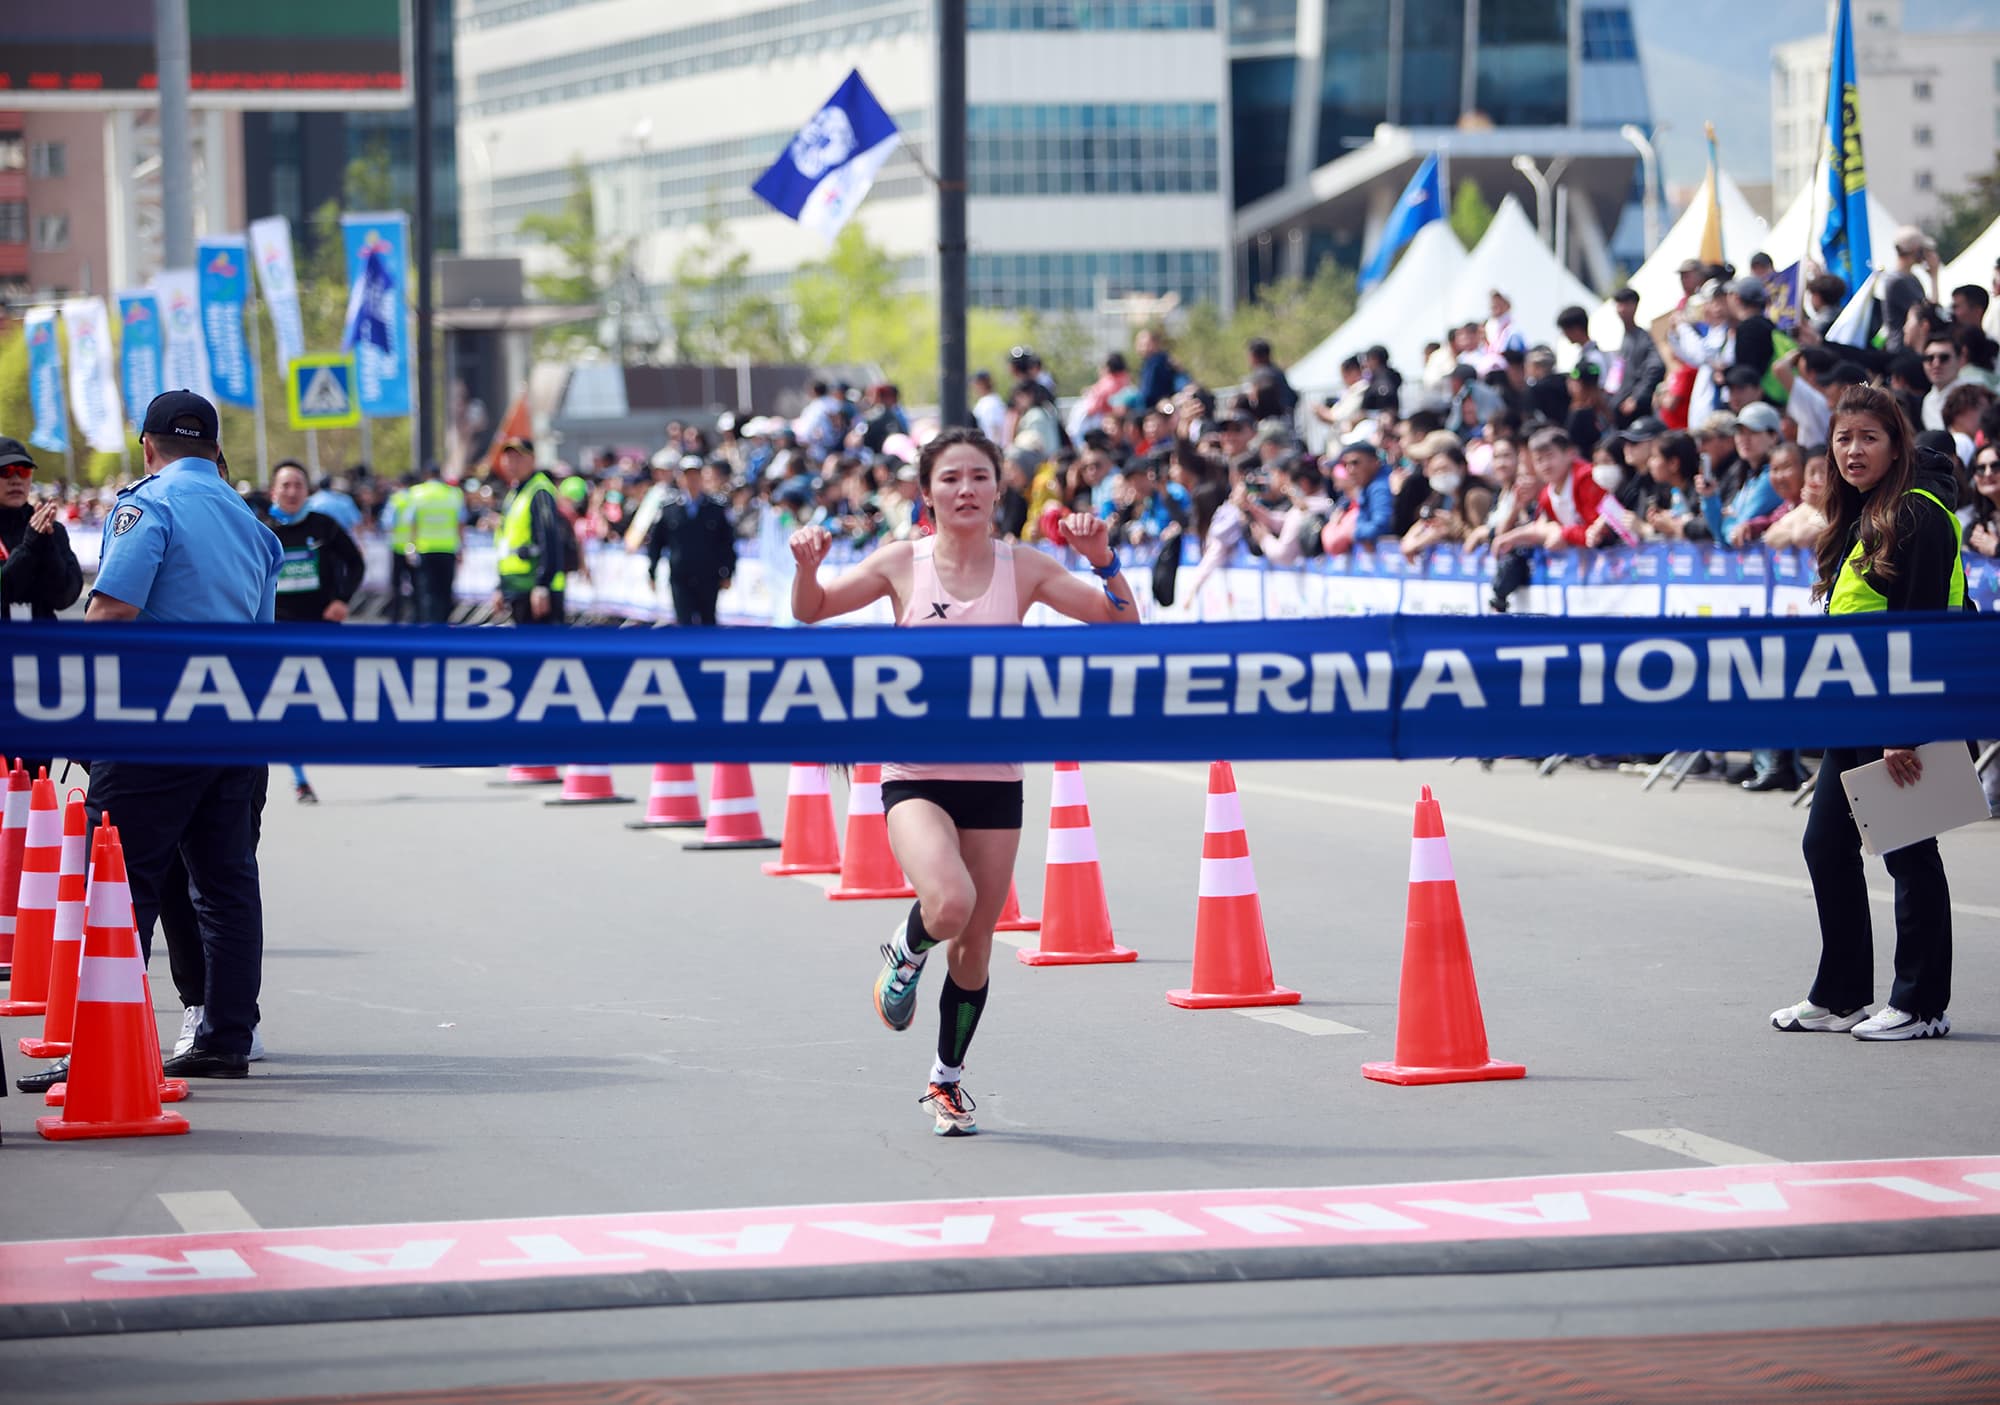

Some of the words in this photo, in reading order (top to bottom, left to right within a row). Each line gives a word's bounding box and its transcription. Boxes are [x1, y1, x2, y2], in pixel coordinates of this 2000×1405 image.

[175, 427, 201, 437] POLICE
[12, 654, 928, 723] ULAANBAATAR
[968, 630, 1946, 719] INTERNATIONAL
